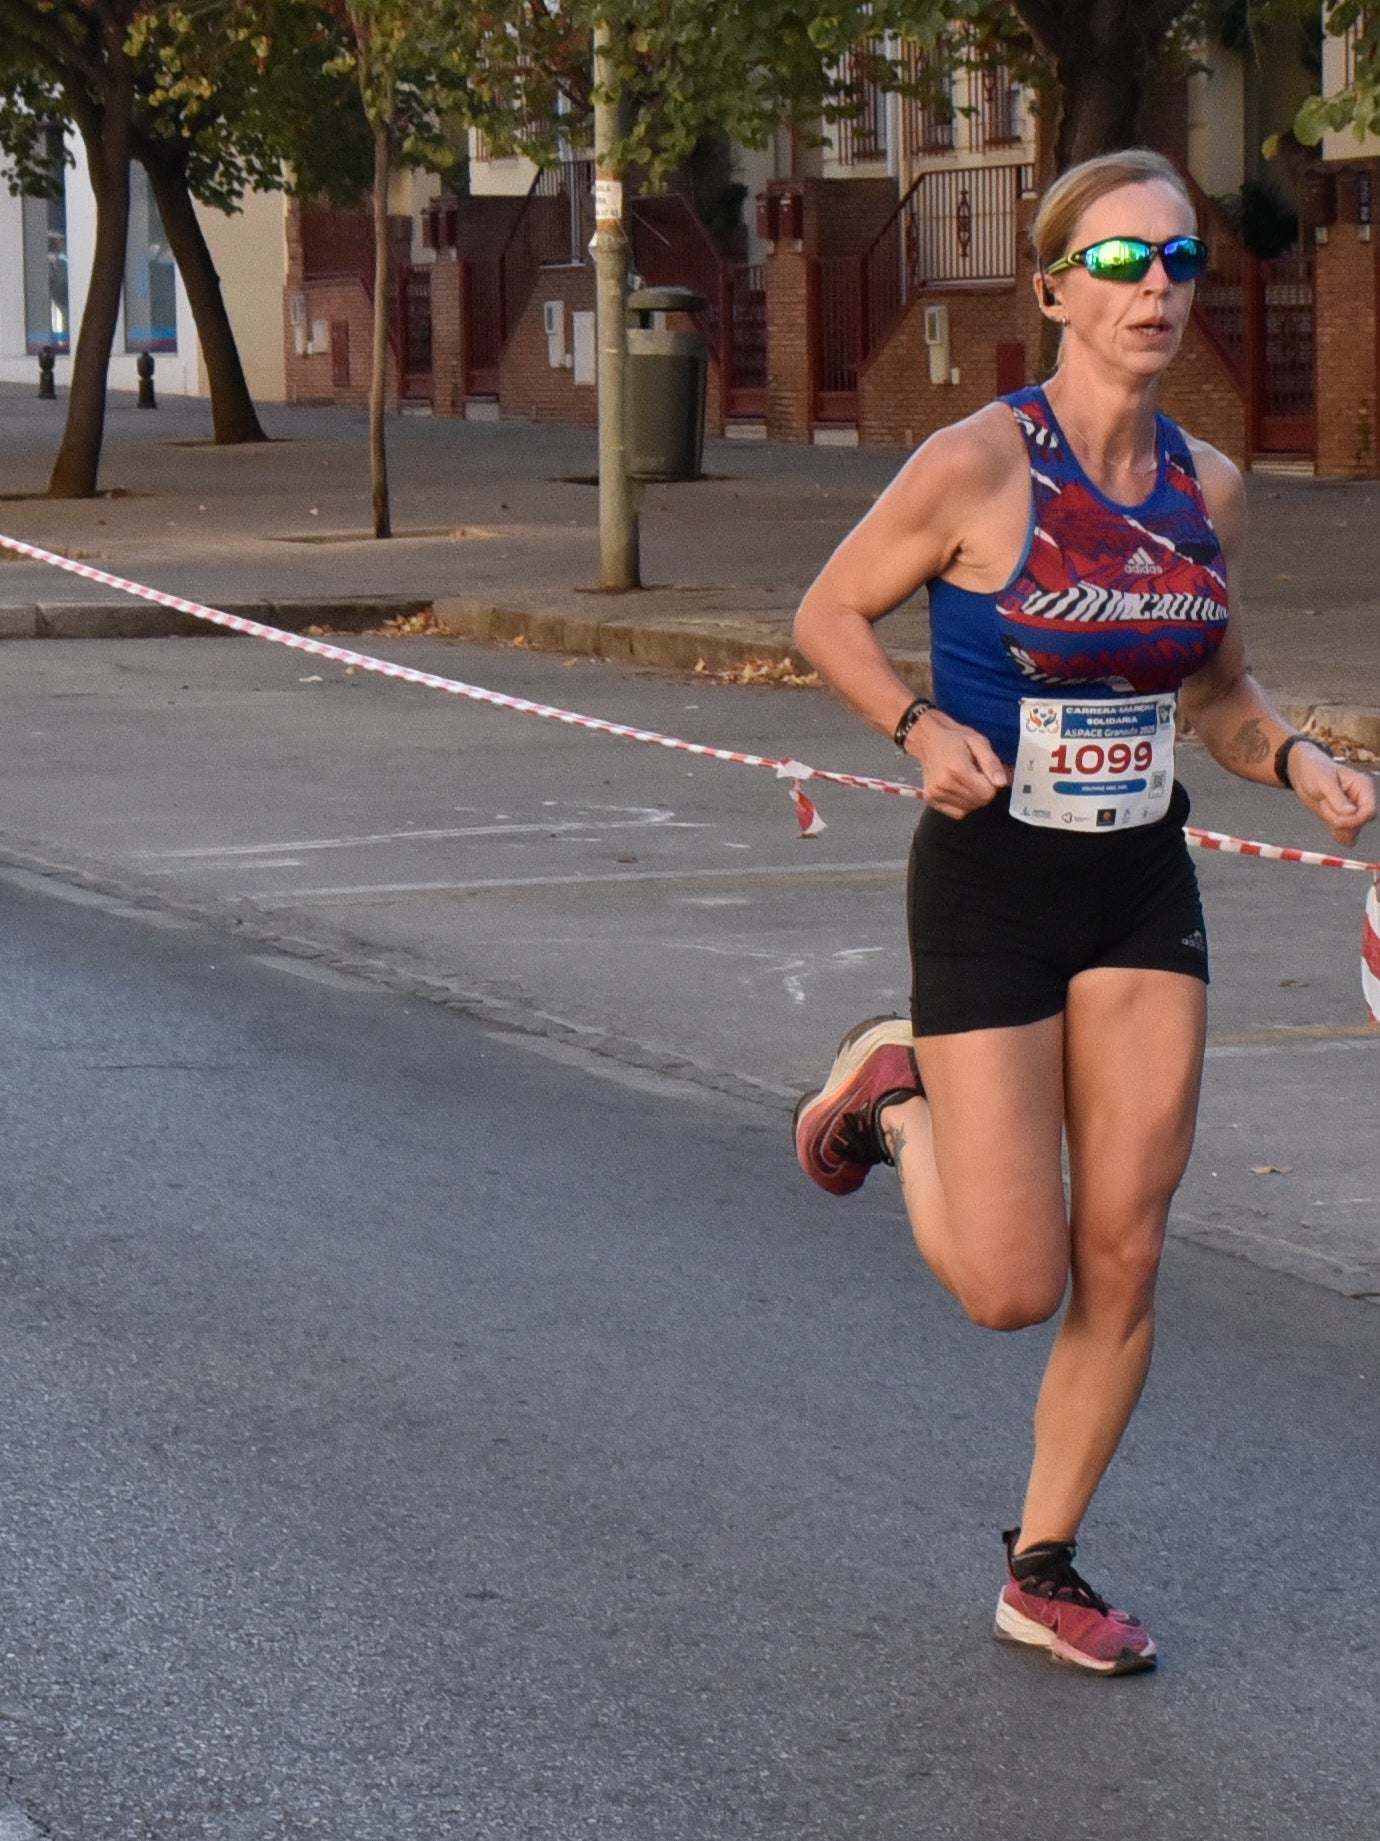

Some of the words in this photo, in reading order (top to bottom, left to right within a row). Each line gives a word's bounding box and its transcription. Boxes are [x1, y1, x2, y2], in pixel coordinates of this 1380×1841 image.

[1124, 563, 1164, 574] adidas
[1065, 707, 1117, 715] CARRERA
[1086, 716, 1138, 726] SOLIDARIA
[1064, 729, 1103, 738] ASPACE
[1049, 741, 1153, 775] 1099
